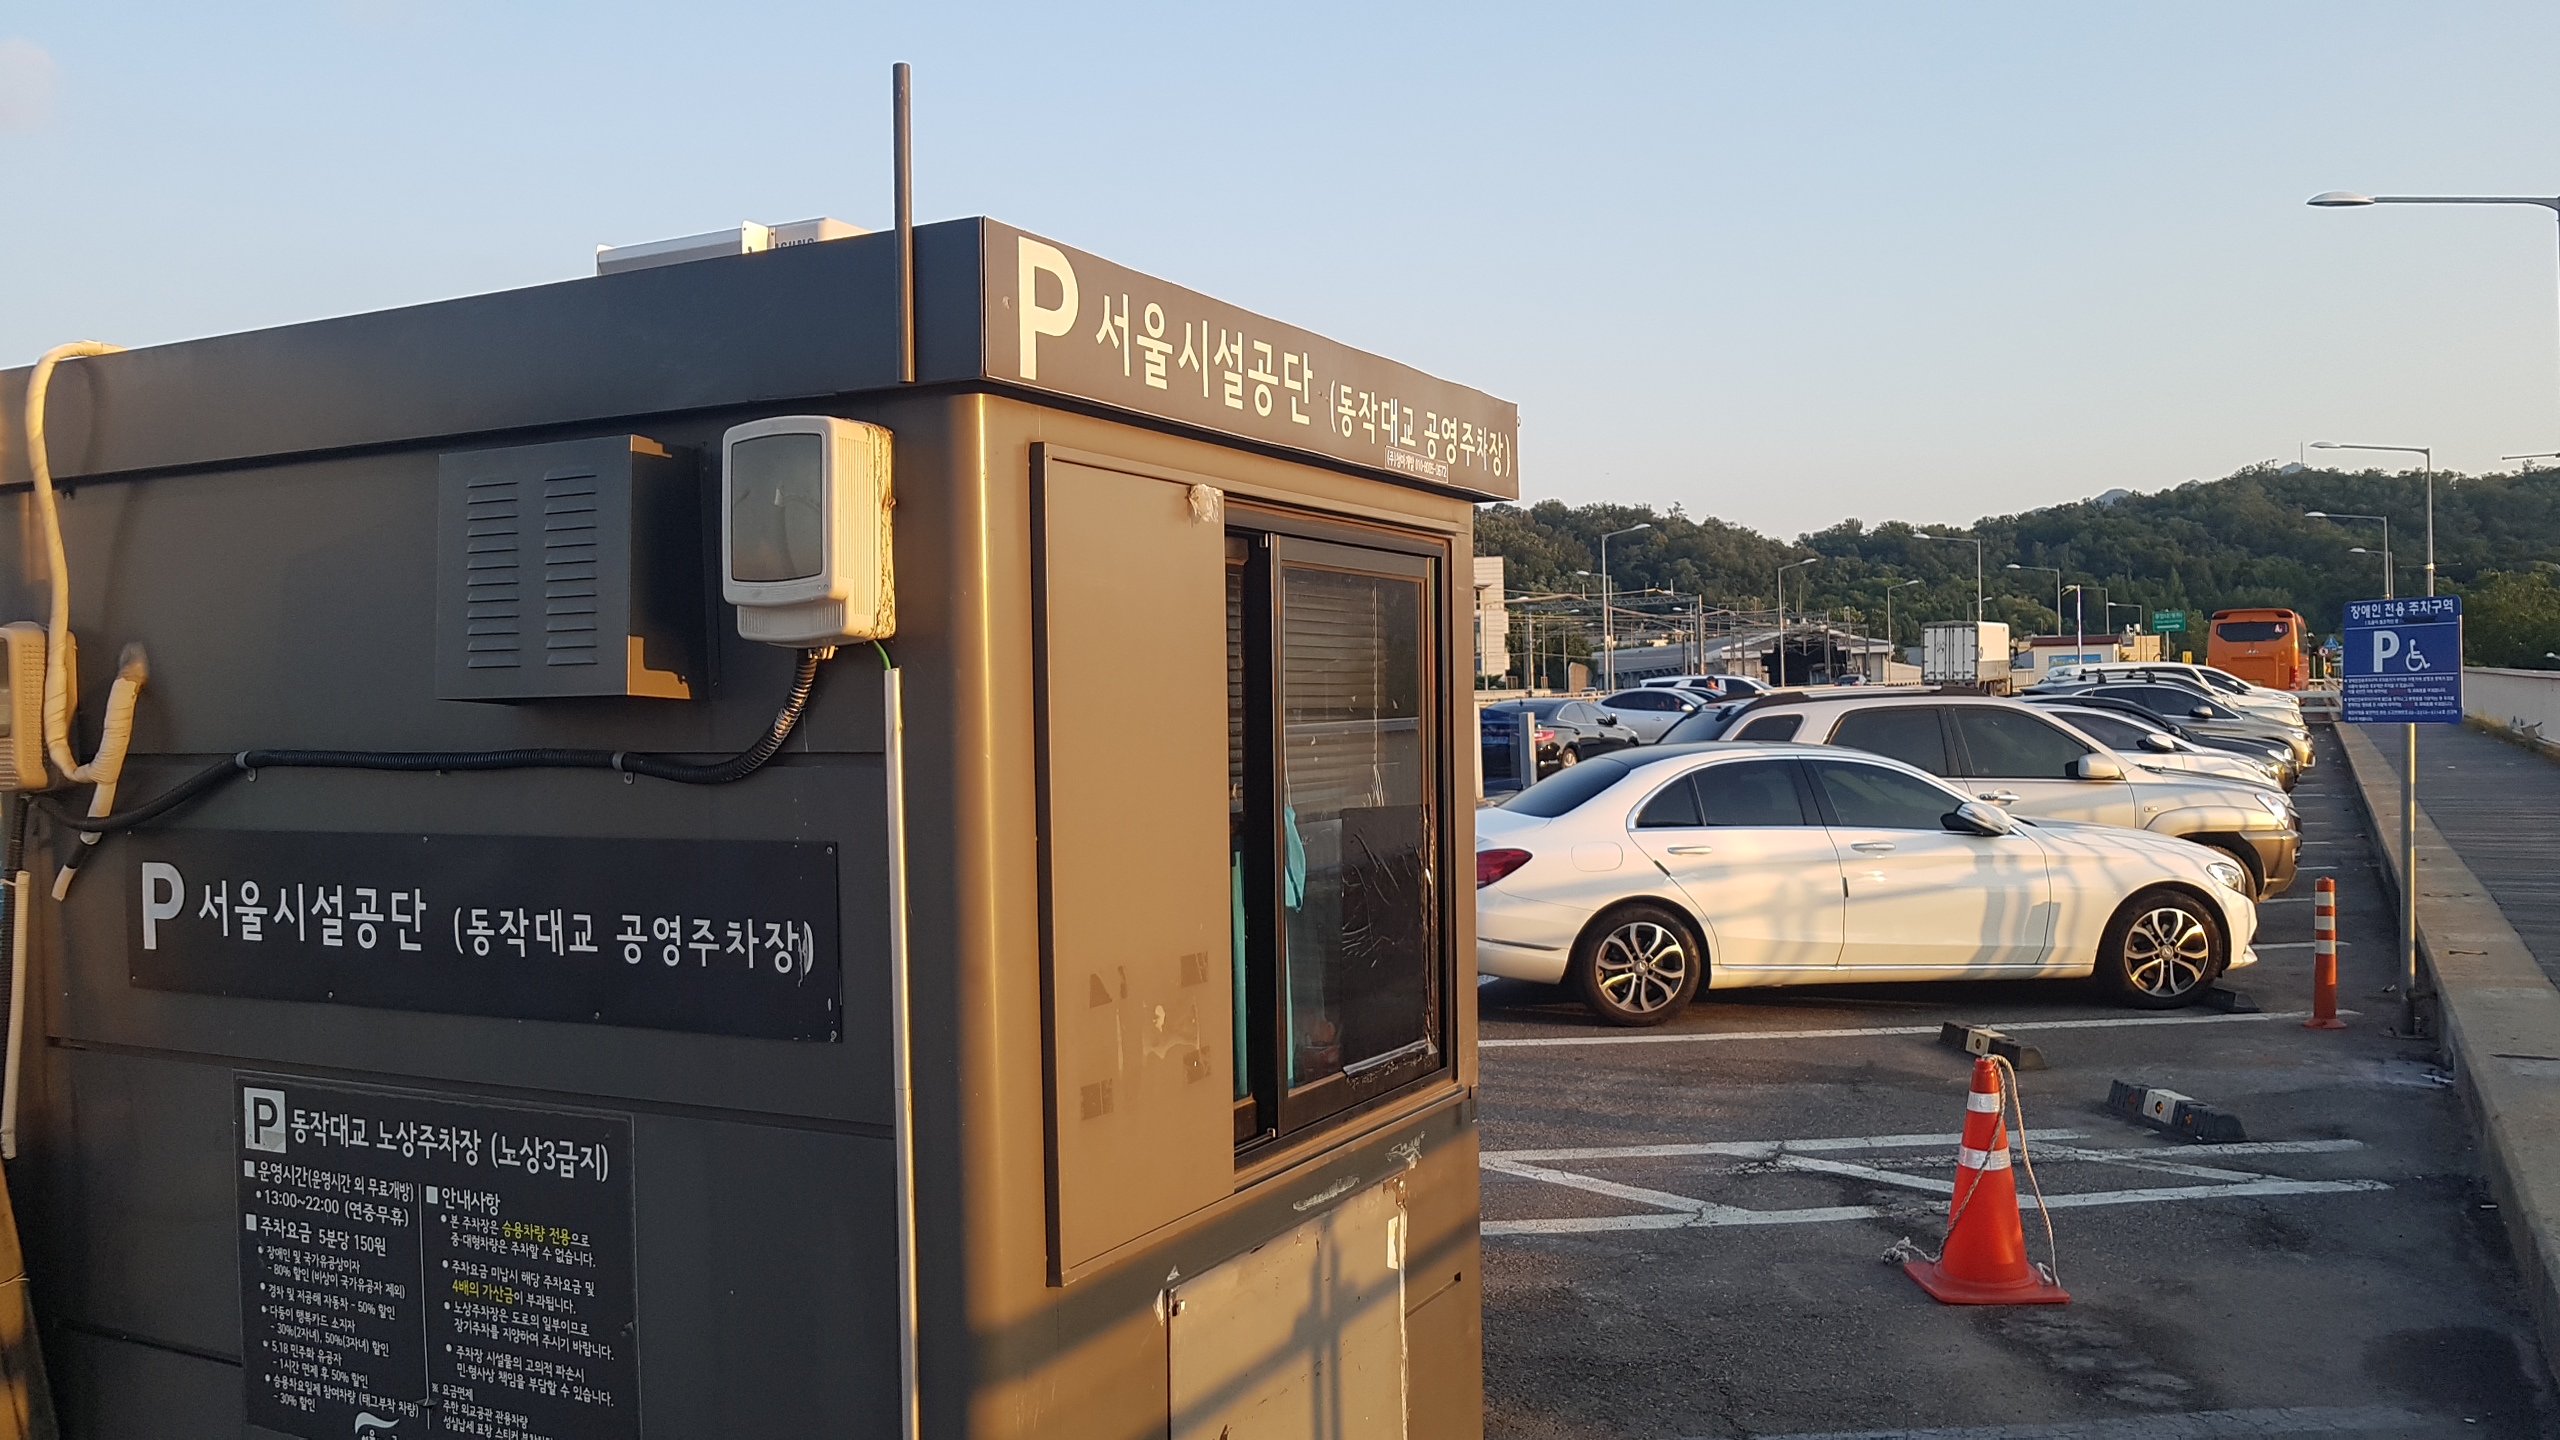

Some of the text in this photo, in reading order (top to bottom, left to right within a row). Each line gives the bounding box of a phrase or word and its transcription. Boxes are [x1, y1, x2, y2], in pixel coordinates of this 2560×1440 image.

[1018, 235, 1079, 380] P
[1096, 293, 1511, 477] 서울시설공단 (동작대교 공영주차장)
[2351, 599, 2454, 619] 장애인 전용 주차구역
[2374, 630, 2399, 672] P
[142, 862, 185, 950] P
[198, 879, 814, 975] 서울시설공단 (동작대교 공영주차장)
[253, 1097, 278, 1144] P
[291, 1109, 608, 1182] 동작대교 노상주차장 (노상3급지)
[258, 1161, 414, 1202] 운영시간(운영시간 외 무료개방)
[264, 1190, 408, 1227] 13:00~22:00 (연중무휴)
[442, 1187, 500, 1216] 안내사항
[260, 1216, 386, 1256] 주차요금 5분당 150원
[450, 1214, 590, 1247] 본 주차장은 승용차량 전용으로
[266, 1246, 360, 1274] 장애인 및 국가유공상이자
[511, 1242, 539, 1260] 주차할
[542, 1248, 552, 1260] 수
[555, 1248, 596, 1268] 없습니다.
[274, 1264, 406, 1299] 80% 할인 (비상이 국가유공자 제외)
[452, 1260, 594, 1297] 주차요금 미납시 해당 주차요금 및
[268, 1284, 395, 1320] 경차 및 저공해 자동차 50% 할인
[452, 1279, 576, 1314] 4배의 가산금이 부과됩니다.
[270, 1305, 356, 1333] 다둥이 행복카드 소지자
[454, 1301, 589, 1336] 노상주차장은 도로의 일부이므로
[290, 1343, 314, 1360] 민주화
[317, 1349, 342, 1366] 유공자
[372, 1340, 389, 1357] 할인
[454, 1318, 614, 1360] 장기주차를 지양하여 주시기 바랍니다.
[279, 1358, 368, 1388] 1시간 면제 후 50% 할인
[456, 1346, 584, 1383] 주차장 시설물의 고의적 파손시
[273, 1374, 419, 1418] 승용차요일제 참여차량 (태그부착 차량)
[280, 1392, 316, 1413] 30% 할인
[442, 1384, 474, 1401] 요금면제
[499, 1370, 525, 1390] 책임을
[528, 1377, 556, 1396] 부담할
[560, 1384, 570, 1398] 수
[573, 1386, 614, 1407] 있습니다.
[443, 1400, 528, 1429] 주한 외교공관 관용차량
[443, 1416, 474, 1434] 성실납세
[476, 1423, 492, 1438] 표창
[495, 1428, 518, 1440] 스티커
